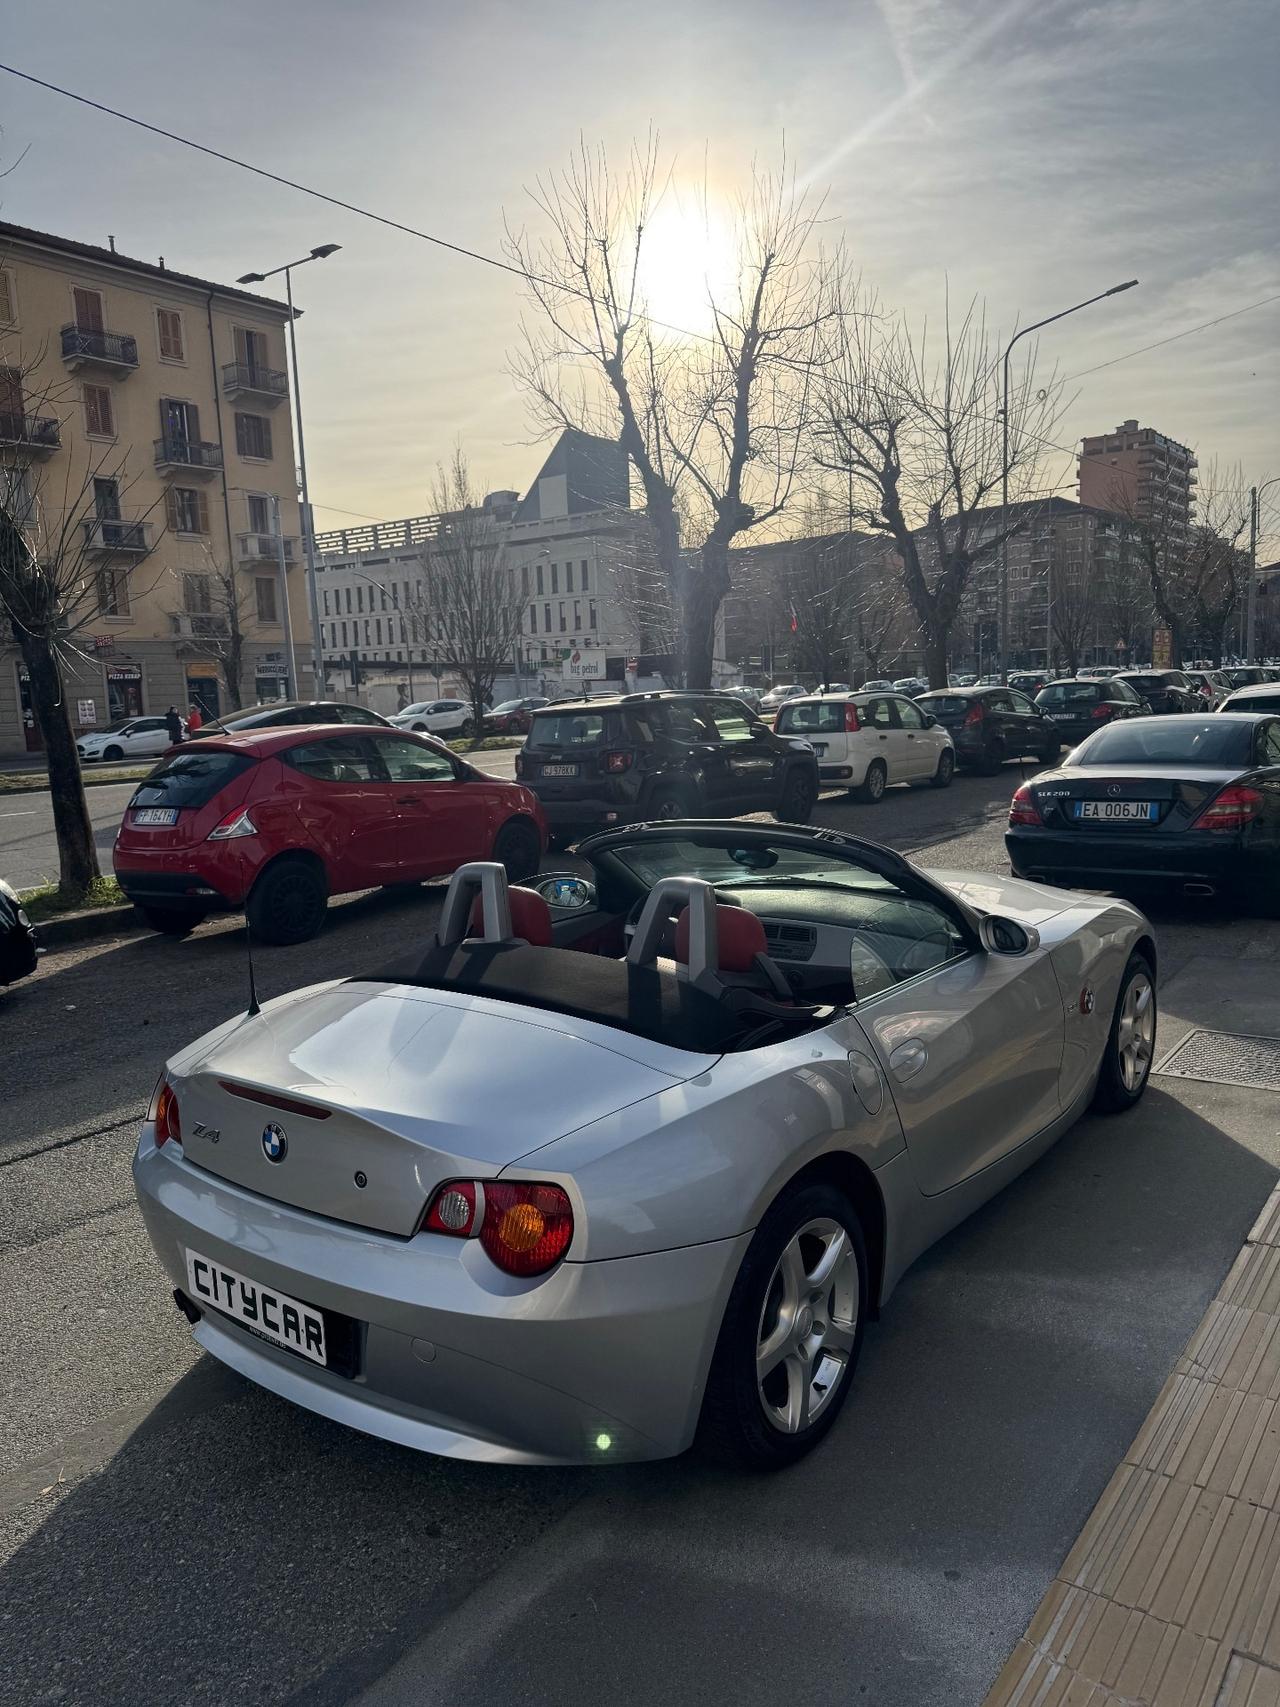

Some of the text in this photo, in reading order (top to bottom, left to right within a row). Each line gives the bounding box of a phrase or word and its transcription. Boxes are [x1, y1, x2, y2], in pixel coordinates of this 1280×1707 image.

[1083, 803, 1149, 818] EA 006JN
[192, 1121, 221, 1144] Z4
[193, 1258, 324, 1357] CITYCAR
